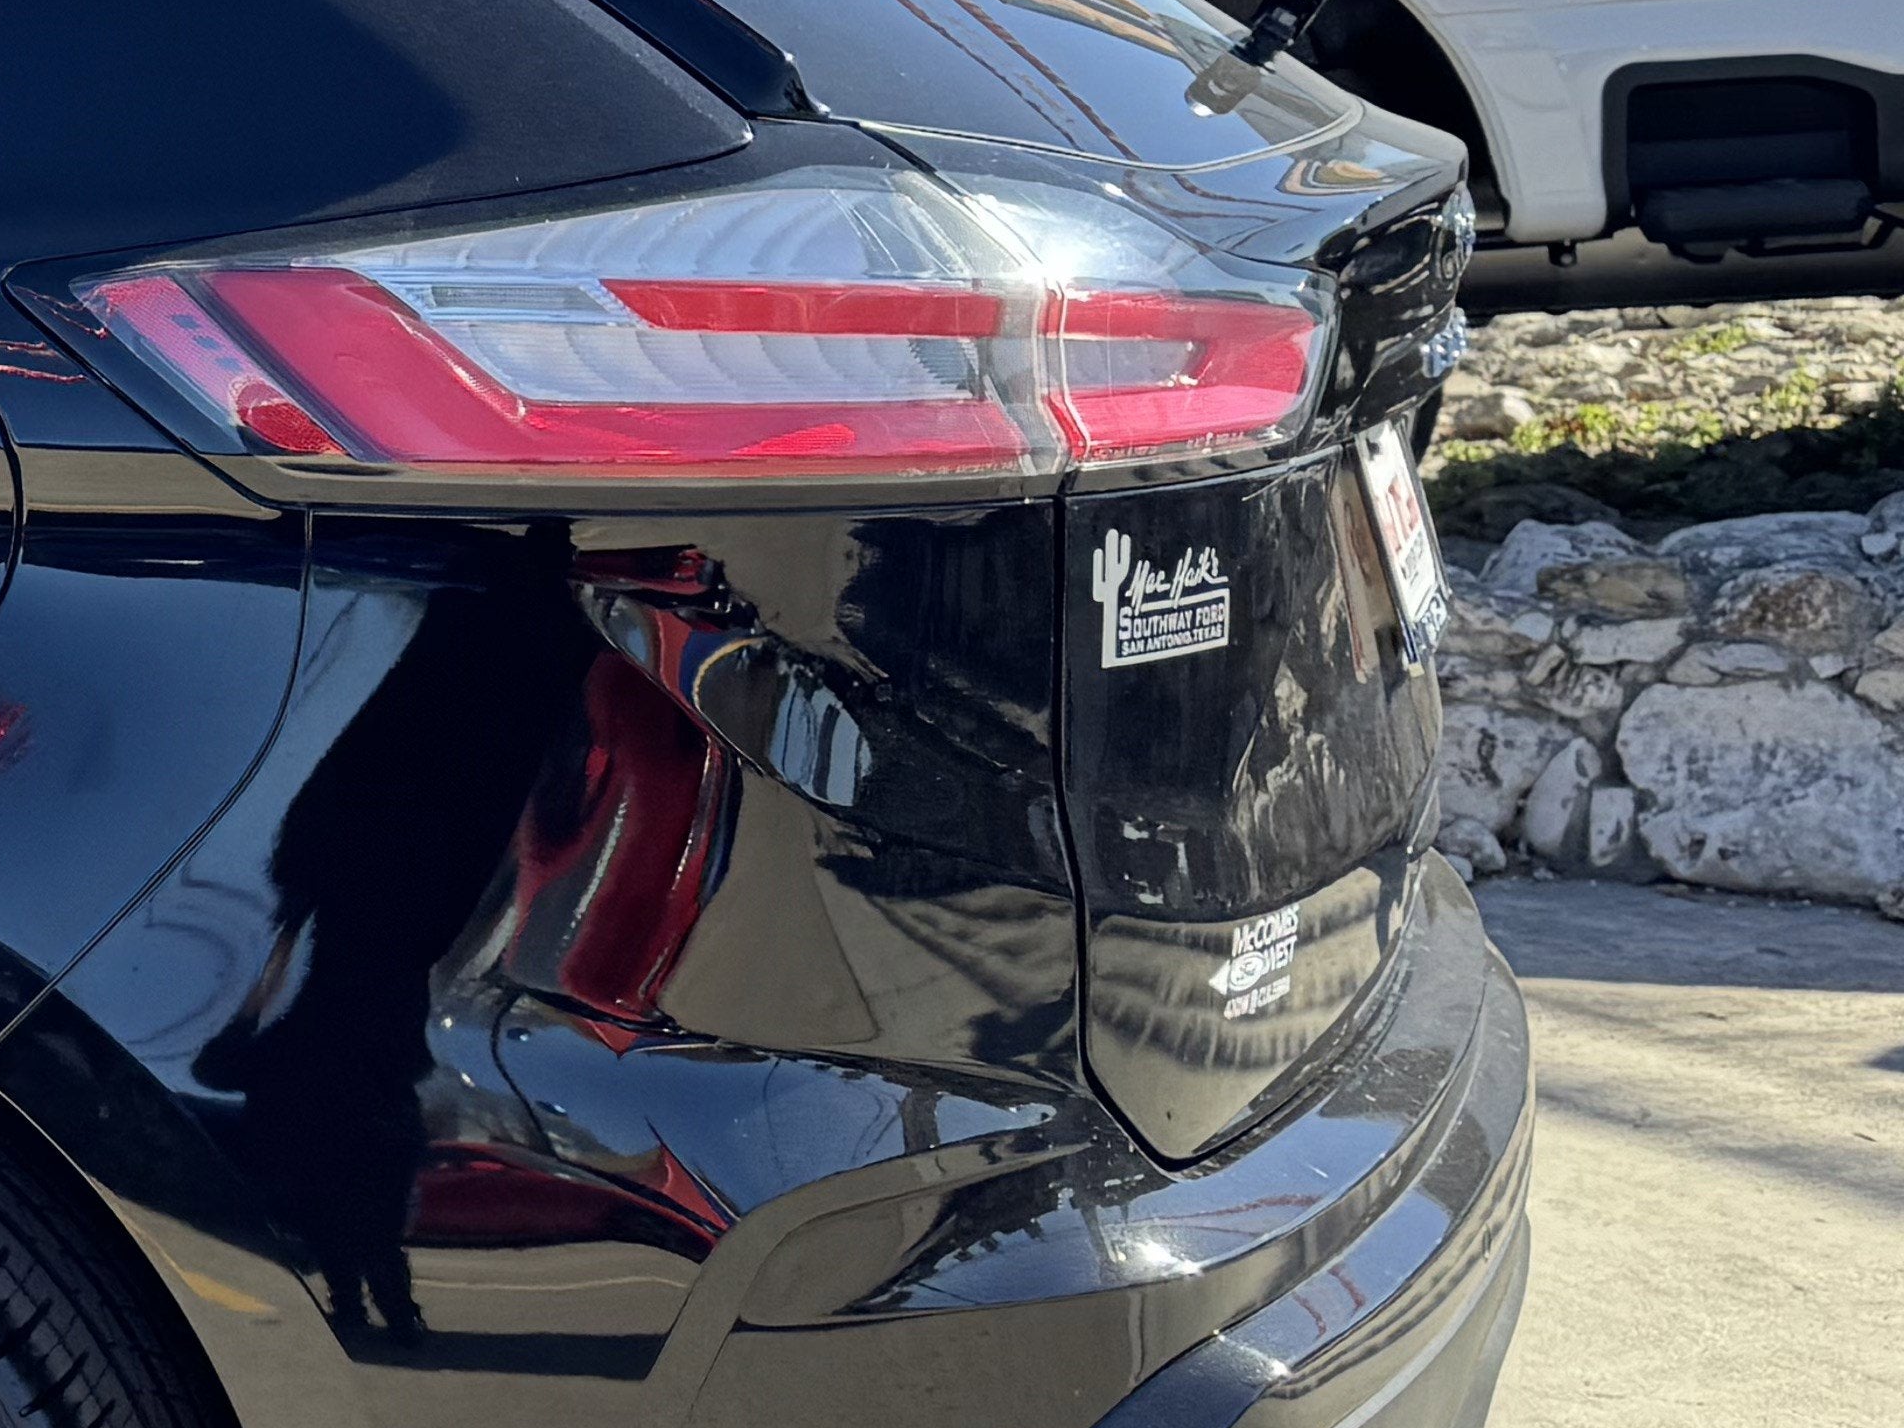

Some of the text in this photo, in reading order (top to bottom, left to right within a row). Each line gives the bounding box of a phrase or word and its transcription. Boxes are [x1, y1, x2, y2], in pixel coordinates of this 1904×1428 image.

[1124, 560, 1171, 616] Mac
[1119, 603, 1225, 640] SOUTHWAY FORD
